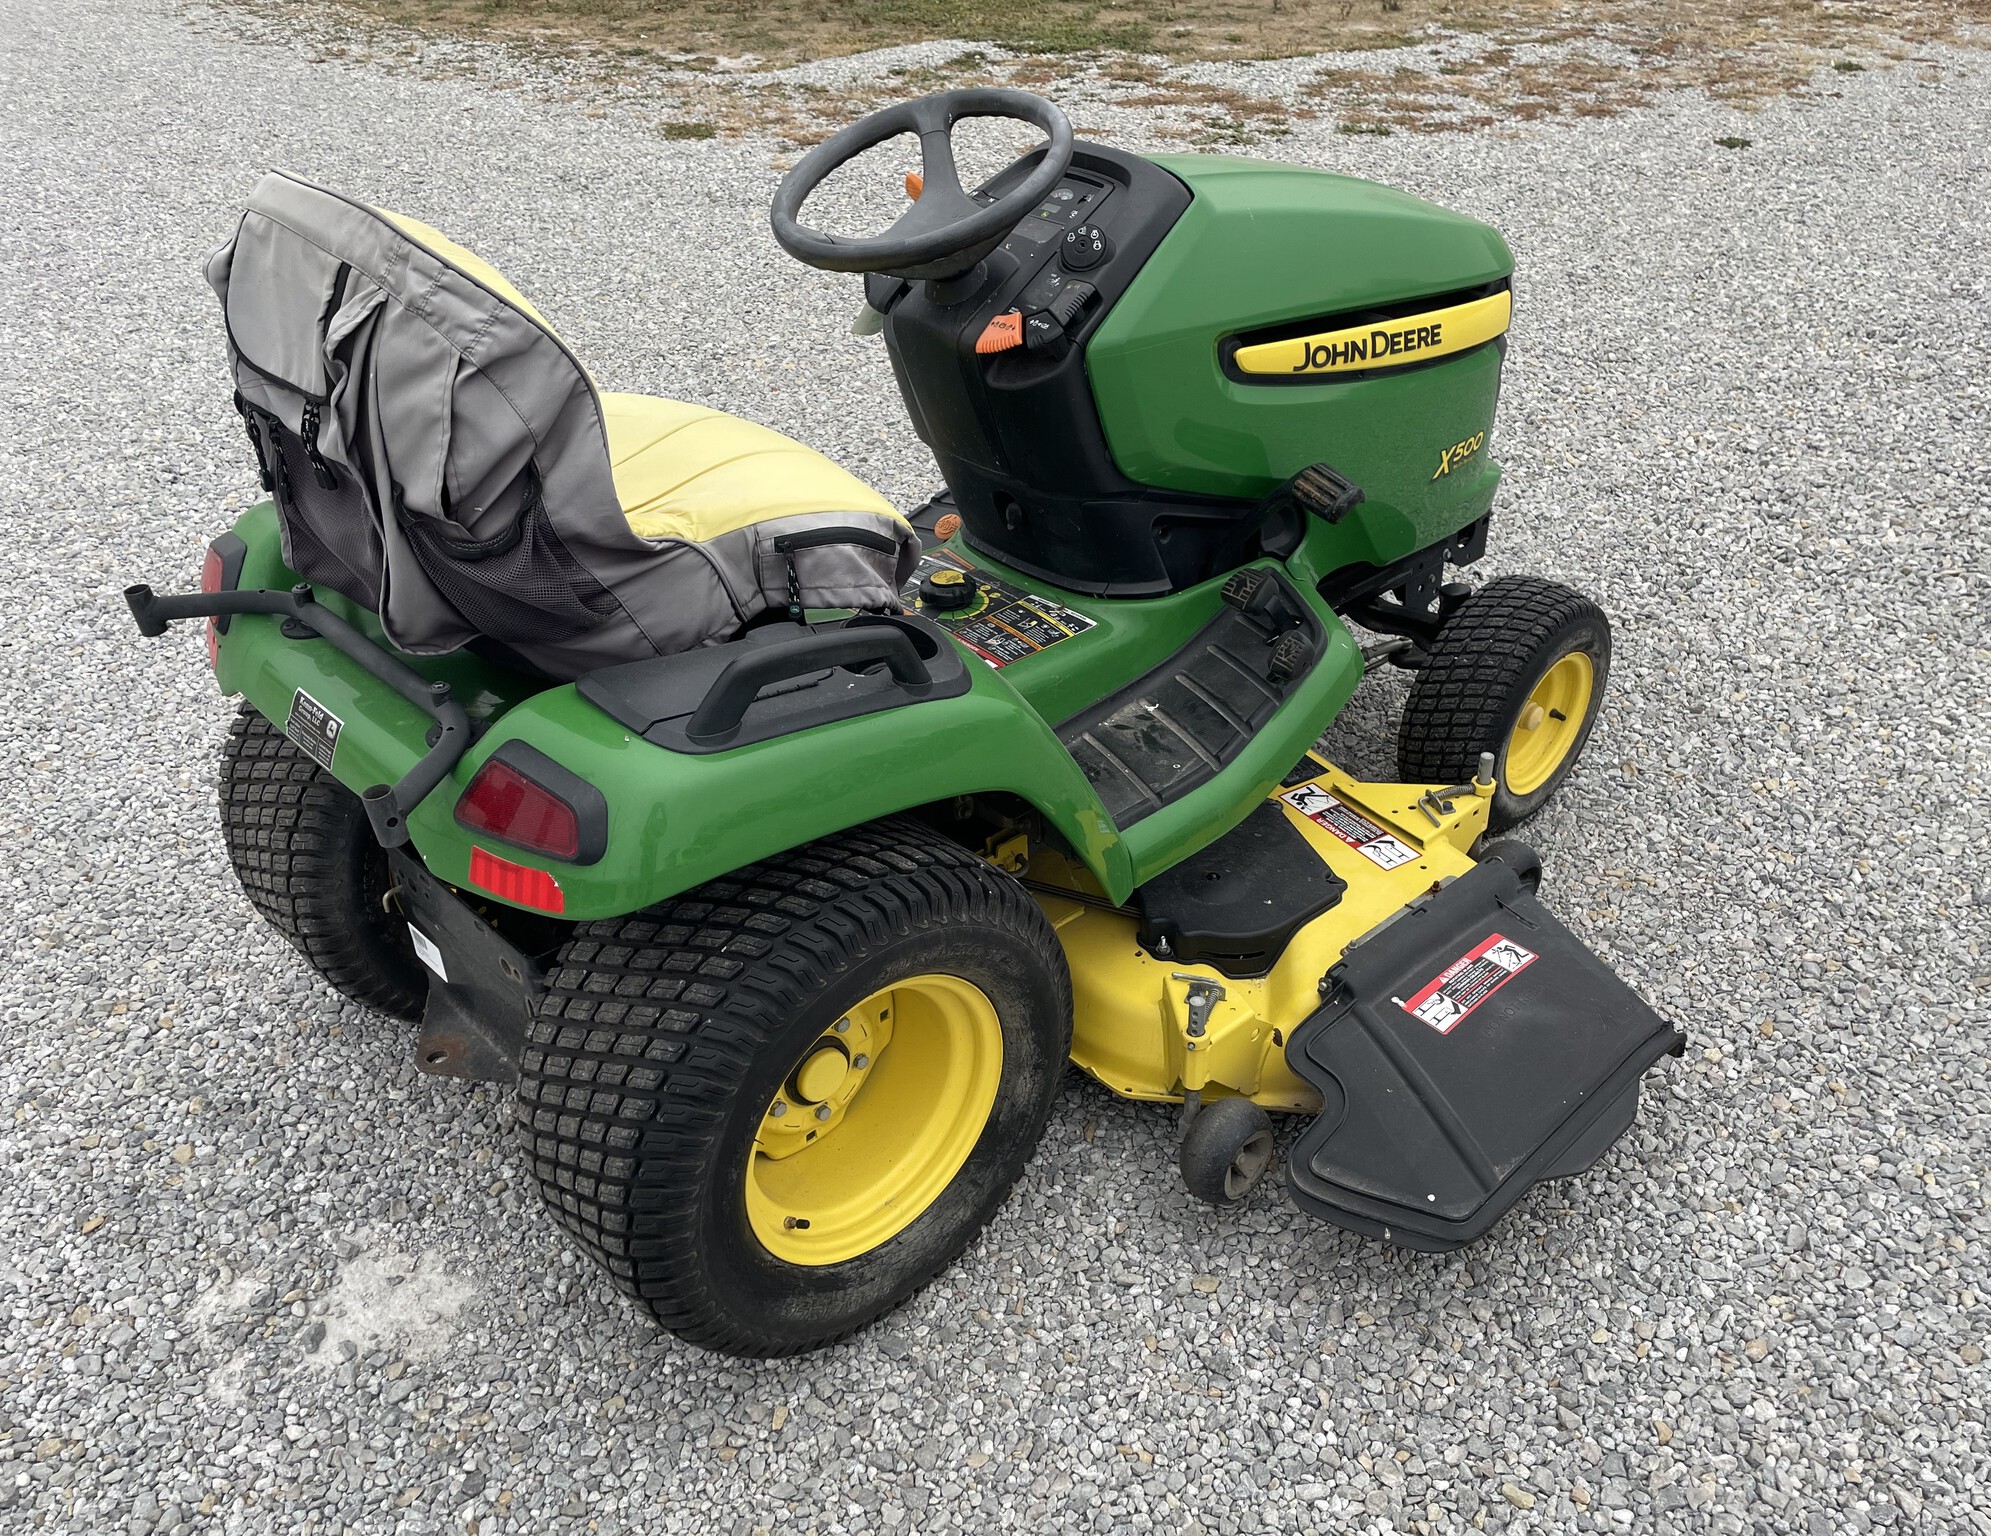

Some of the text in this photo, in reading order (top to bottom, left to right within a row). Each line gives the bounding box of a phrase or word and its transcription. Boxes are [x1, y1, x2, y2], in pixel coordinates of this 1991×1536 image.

[1293, 324, 1442, 372] JOHN DEERE
[1431, 430, 1485, 481] X500
[311, 716, 321, 727] LLC
[1316, 817, 1347, 839] DANGER
[1444, 957, 1472, 979] DANGER
[1483, 1020, 1501, 1037] DO
[1499, 1002, 1521, 1023] NOT
